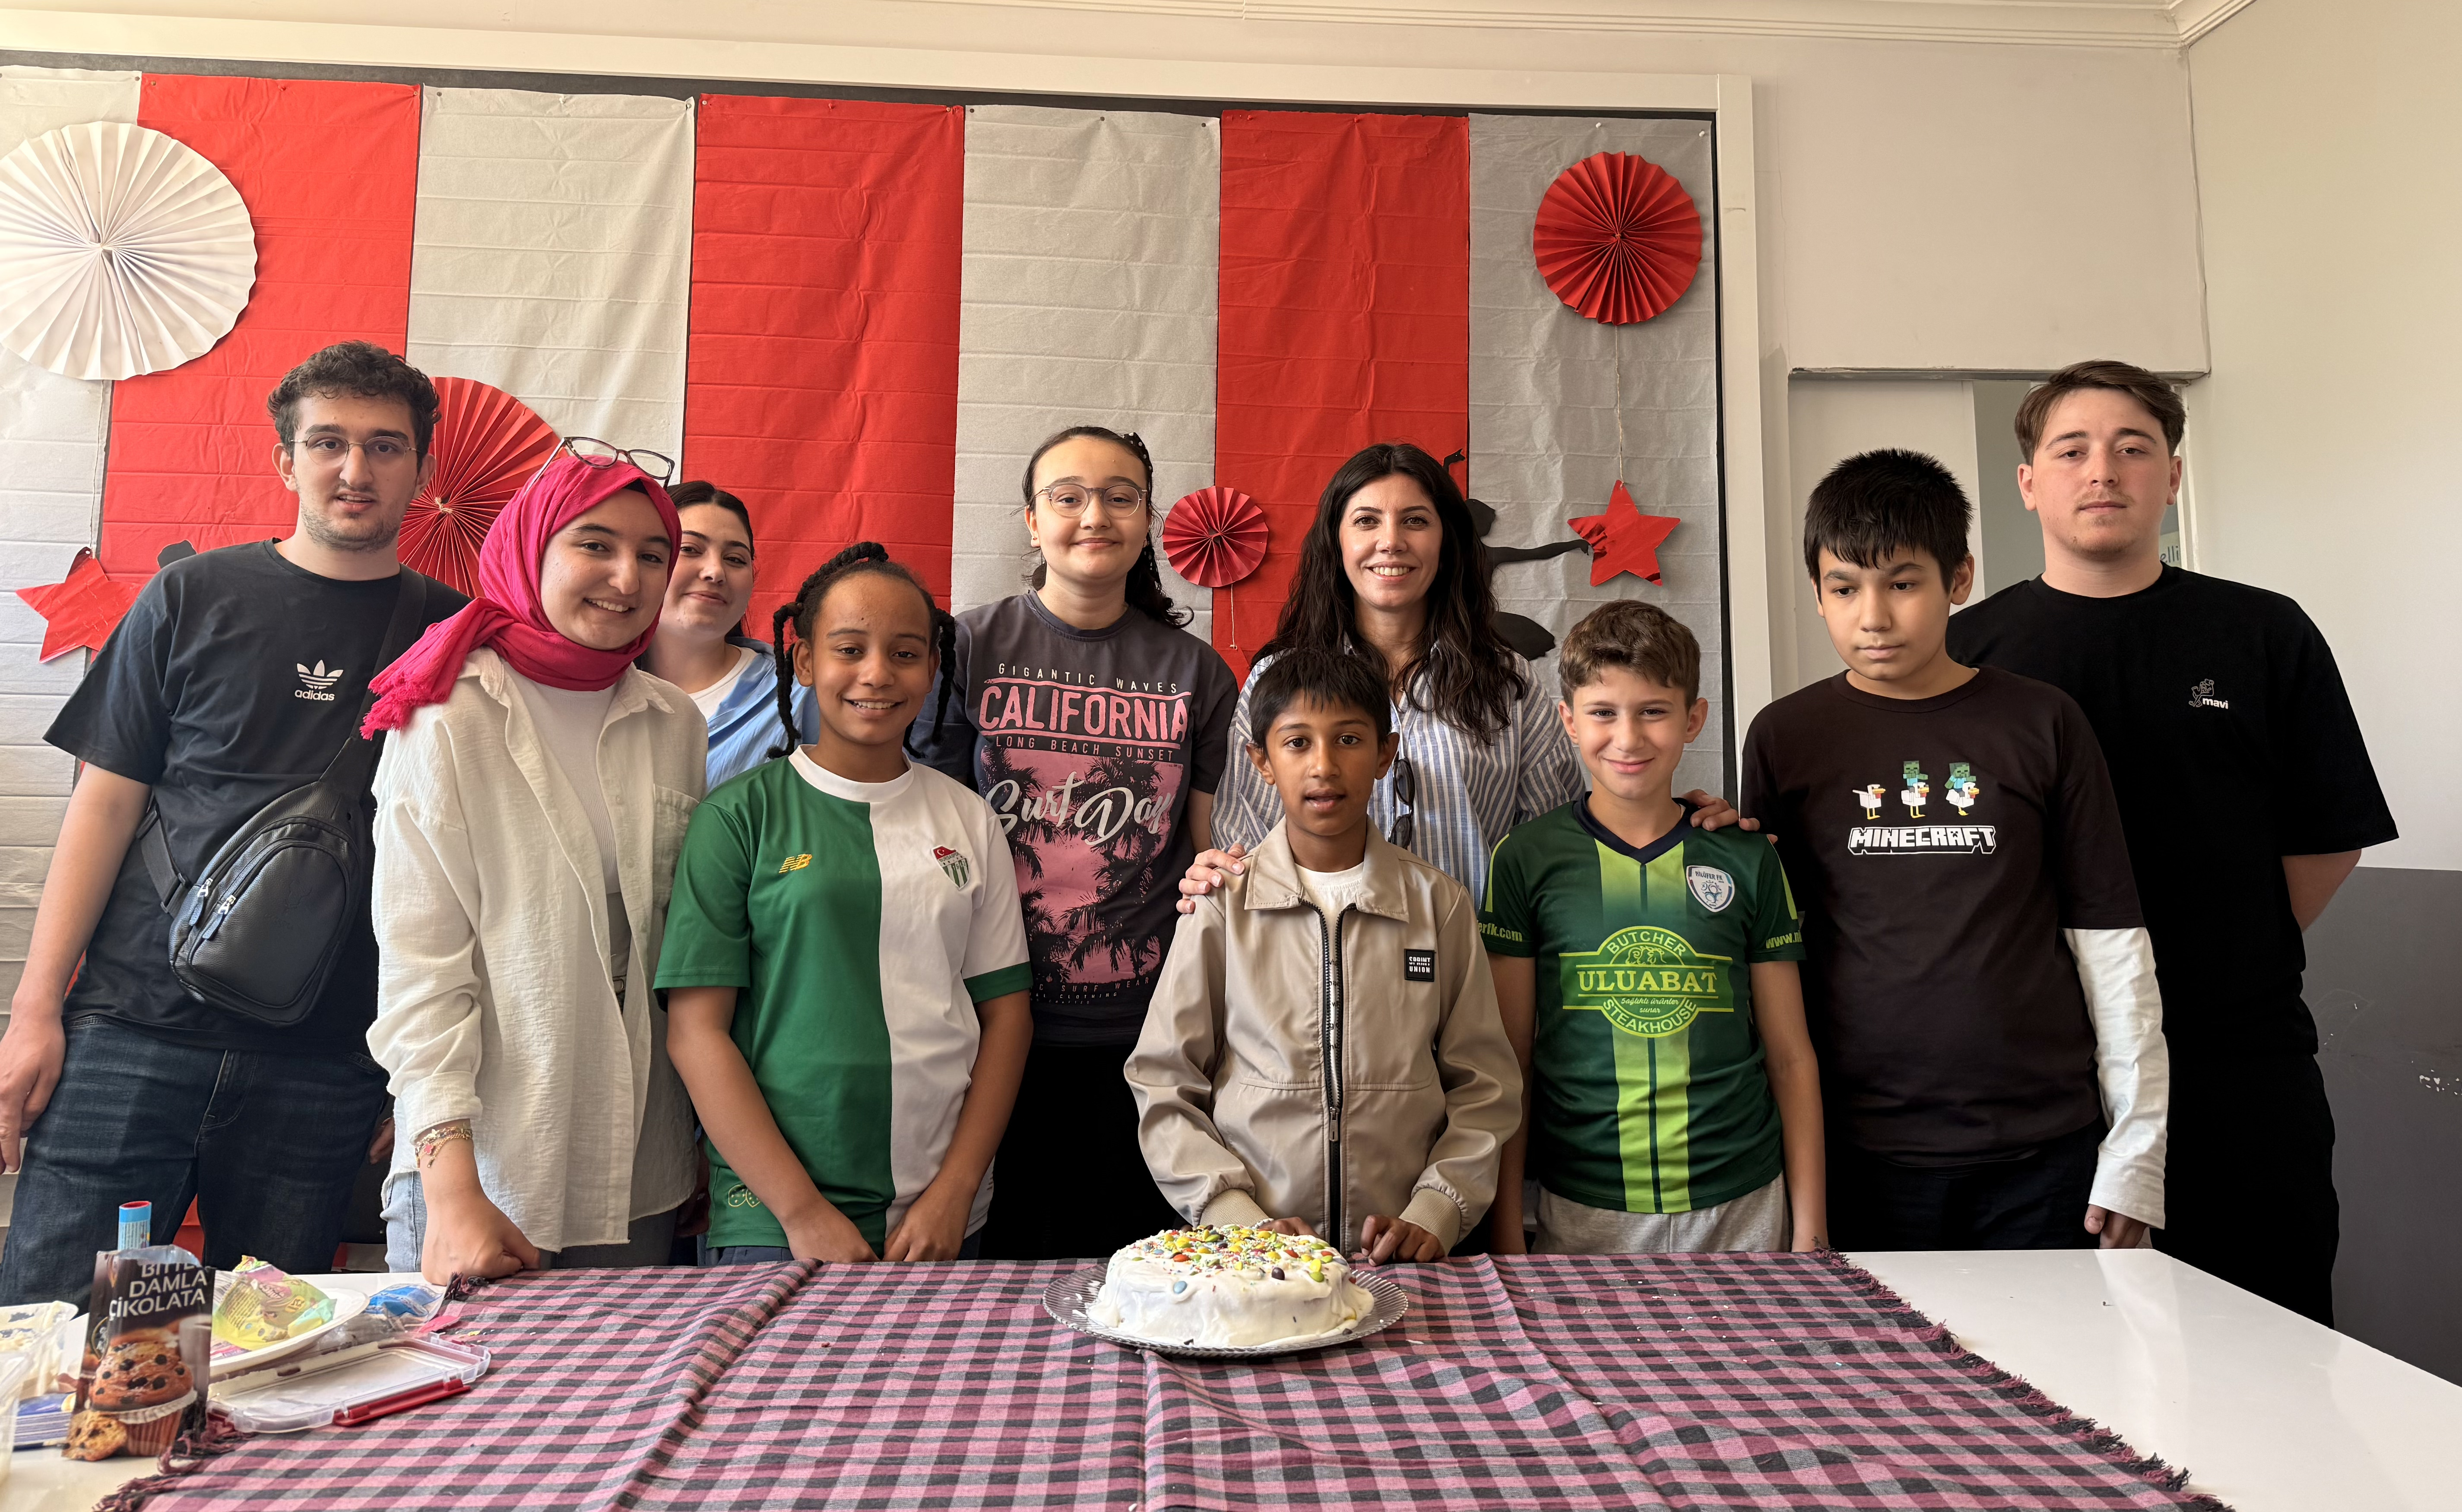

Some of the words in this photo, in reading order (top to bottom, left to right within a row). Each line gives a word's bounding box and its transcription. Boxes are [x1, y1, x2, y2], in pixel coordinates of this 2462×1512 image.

[999, 663, 1095, 685] GIGANTIC
[1116, 678, 1177, 694] WAVES
[294, 690, 335, 701] adidas
[2202, 697, 2229, 710] mavi
[979, 685, 1188, 743] CALIFORNIA
[996, 736, 1035, 748] LONG
[1051, 740, 1100, 756] BEACH
[1116, 746, 1173, 762] SUNSET
[985, 771, 1085, 835] Surf
[1074, 787, 1175, 846] Day
[1849, 827, 1995, 851] MINECRAFT
[778, 854, 812, 873] NB
[1477, 920, 1523, 942] erfk.com
[1606, 931, 1686, 957] BUTCHER
[1115, 977, 1149, 989] WEAR
[1577, 971, 1717, 993] ULUABAT
[1603, 999, 1697, 1033] STEAKHOUSE
[129, 1270, 207, 1298] DAMLA
[108, 1288, 206, 1322] ÇİKOLATA
